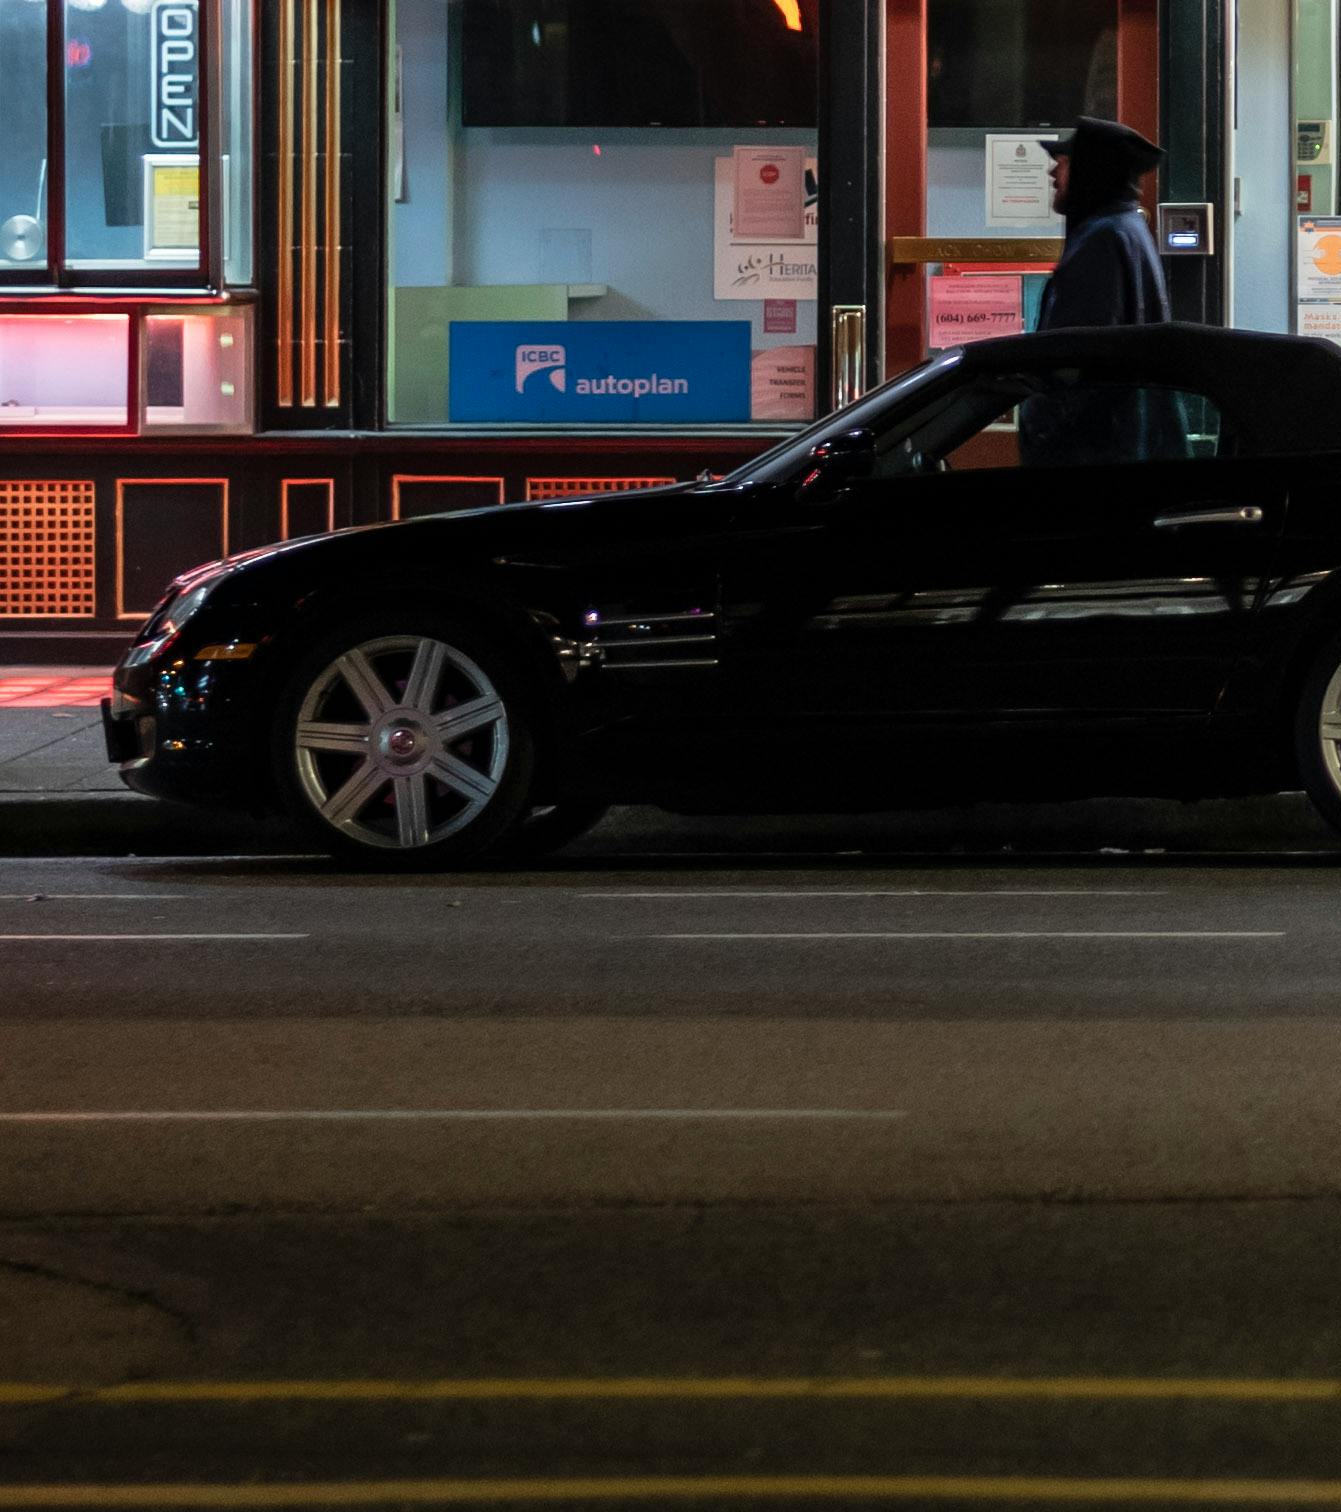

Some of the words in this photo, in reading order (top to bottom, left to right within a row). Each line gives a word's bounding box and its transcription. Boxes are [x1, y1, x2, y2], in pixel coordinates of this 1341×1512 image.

[161, 8, 194, 139] OPEN
[936, 312, 964, 325] (604)
[967, 312, 1016, 324] 669-7777
[522, 350, 560, 363] ICBC
[576, 373, 688, 398] autoplan
